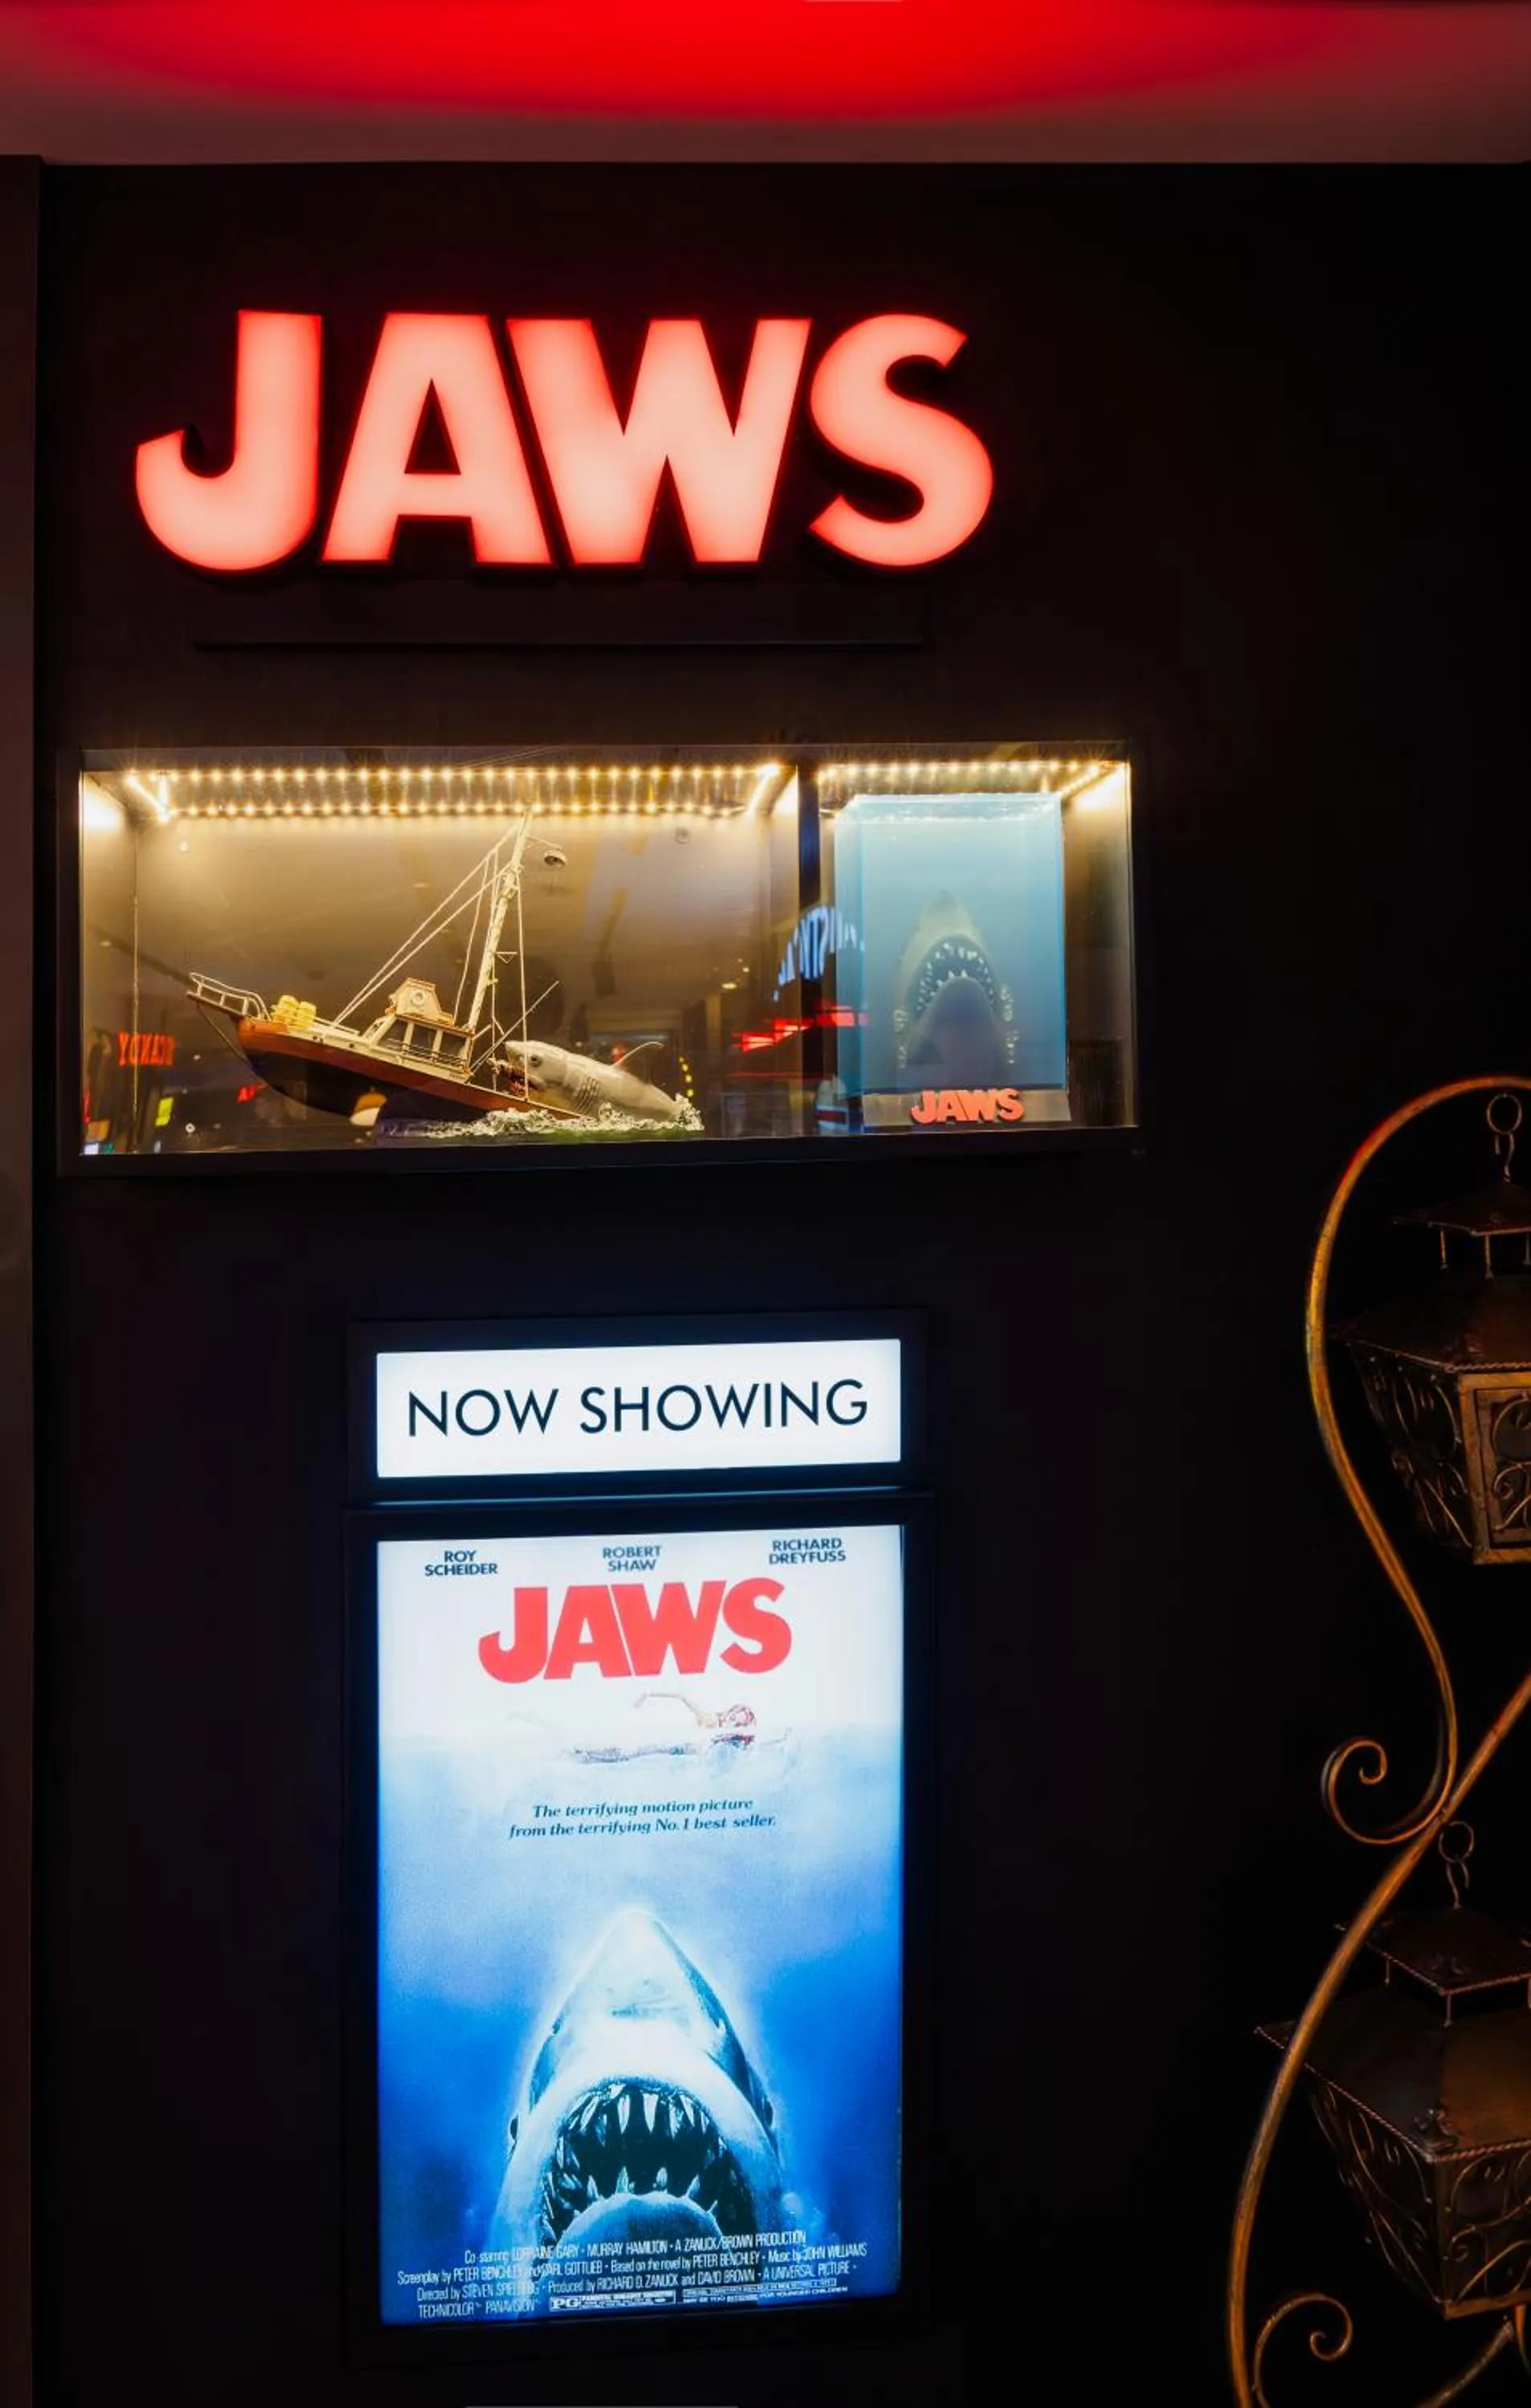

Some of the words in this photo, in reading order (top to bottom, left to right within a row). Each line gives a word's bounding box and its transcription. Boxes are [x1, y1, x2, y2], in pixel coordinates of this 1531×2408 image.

[135, 308, 994, 571] JAWS
[911, 1088, 1025, 1124] JAWS
[408, 1388, 559, 1438] NOW
[579, 1378, 868, 1434] SHOWING
[444, 1549, 477, 1562] ROY
[602, 1545, 662, 1560] ROBERT
[772, 1537, 843, 1552] RICHARD
[424, 1562, 498, 1576] SCHEIDER
[607, 1559, 657, 1572] SHAW
[769, 1550, 847, 1565] DREYFUSS
[477, 1576, 793, 1685] JAWS
[533, 1804, 561, 1818] The
[565, 1802, 639, 1818] terrifying
[642, 1800, 696, 1814] motion
[698, 1799, 753, 1814] picture
[509, 1824, 546, 1841] from
[550, 1823, 574, 1837] the
[578, 1820, 652, 1835] terrifying
[656, 1817, 680, 1832] No.
[694, 1816, 727, 1830] best
[733, 1813, 777, 1828] seller.
[587, 2242, 624, 2258] MURRAY
[625, 2239, 668, 2255] HAMILTON
[674, 2239, 682, 2253] A
[755, 2230, 806, 2247] PRODUCTION
[397, 2270, 440, 2286] Screenplay
[441, 2269, 452, 2285] by
[453, 2266, 480, 2283] PETER
[564, 2260, 603, 2276] GOTTLIEB
[611, 2259, 635, 2273] Based
[636, 2260, 646, 2272] on
[648, 2258, 660, 2272] the
[660, 2256, 680, 2271] novel
[681, 2255, 692, 2272] by
[692, 2253, 718, 2268] PETER
[720, 2250, 761, 2267] BENCHLEY
[768, 2248, 791, 2264] Music
[792, 2248, 802, 2264] by
[802, 2245, 825, 2262] JOHN
[826, 2242, 867, 2259] WILLIAMS
[416, 2288, 449, 2302] Directed
[450, 2286, 461, 2300] by
[461, 2283, 493, 2299] STEVEN
[548, 2279, 585, 2294] Produced
[586, 2278, 596, 2294] by
[596, 2276, 634, 2291] RICHARD
[644, 2272, 680, 2288] ZANUCK
[681, 2273, 696, 2286] and
[696, 2270, 722, 2285] DAVID
[723, 2268, 756, 2284] BROWN
[762, 2268, 770, 2280] A
[770, 2264, 816, 2280] UNIVERSAL
[818, 2260, 851, 2276] PICTURE
[551, 2297, 581, 2309] PG
